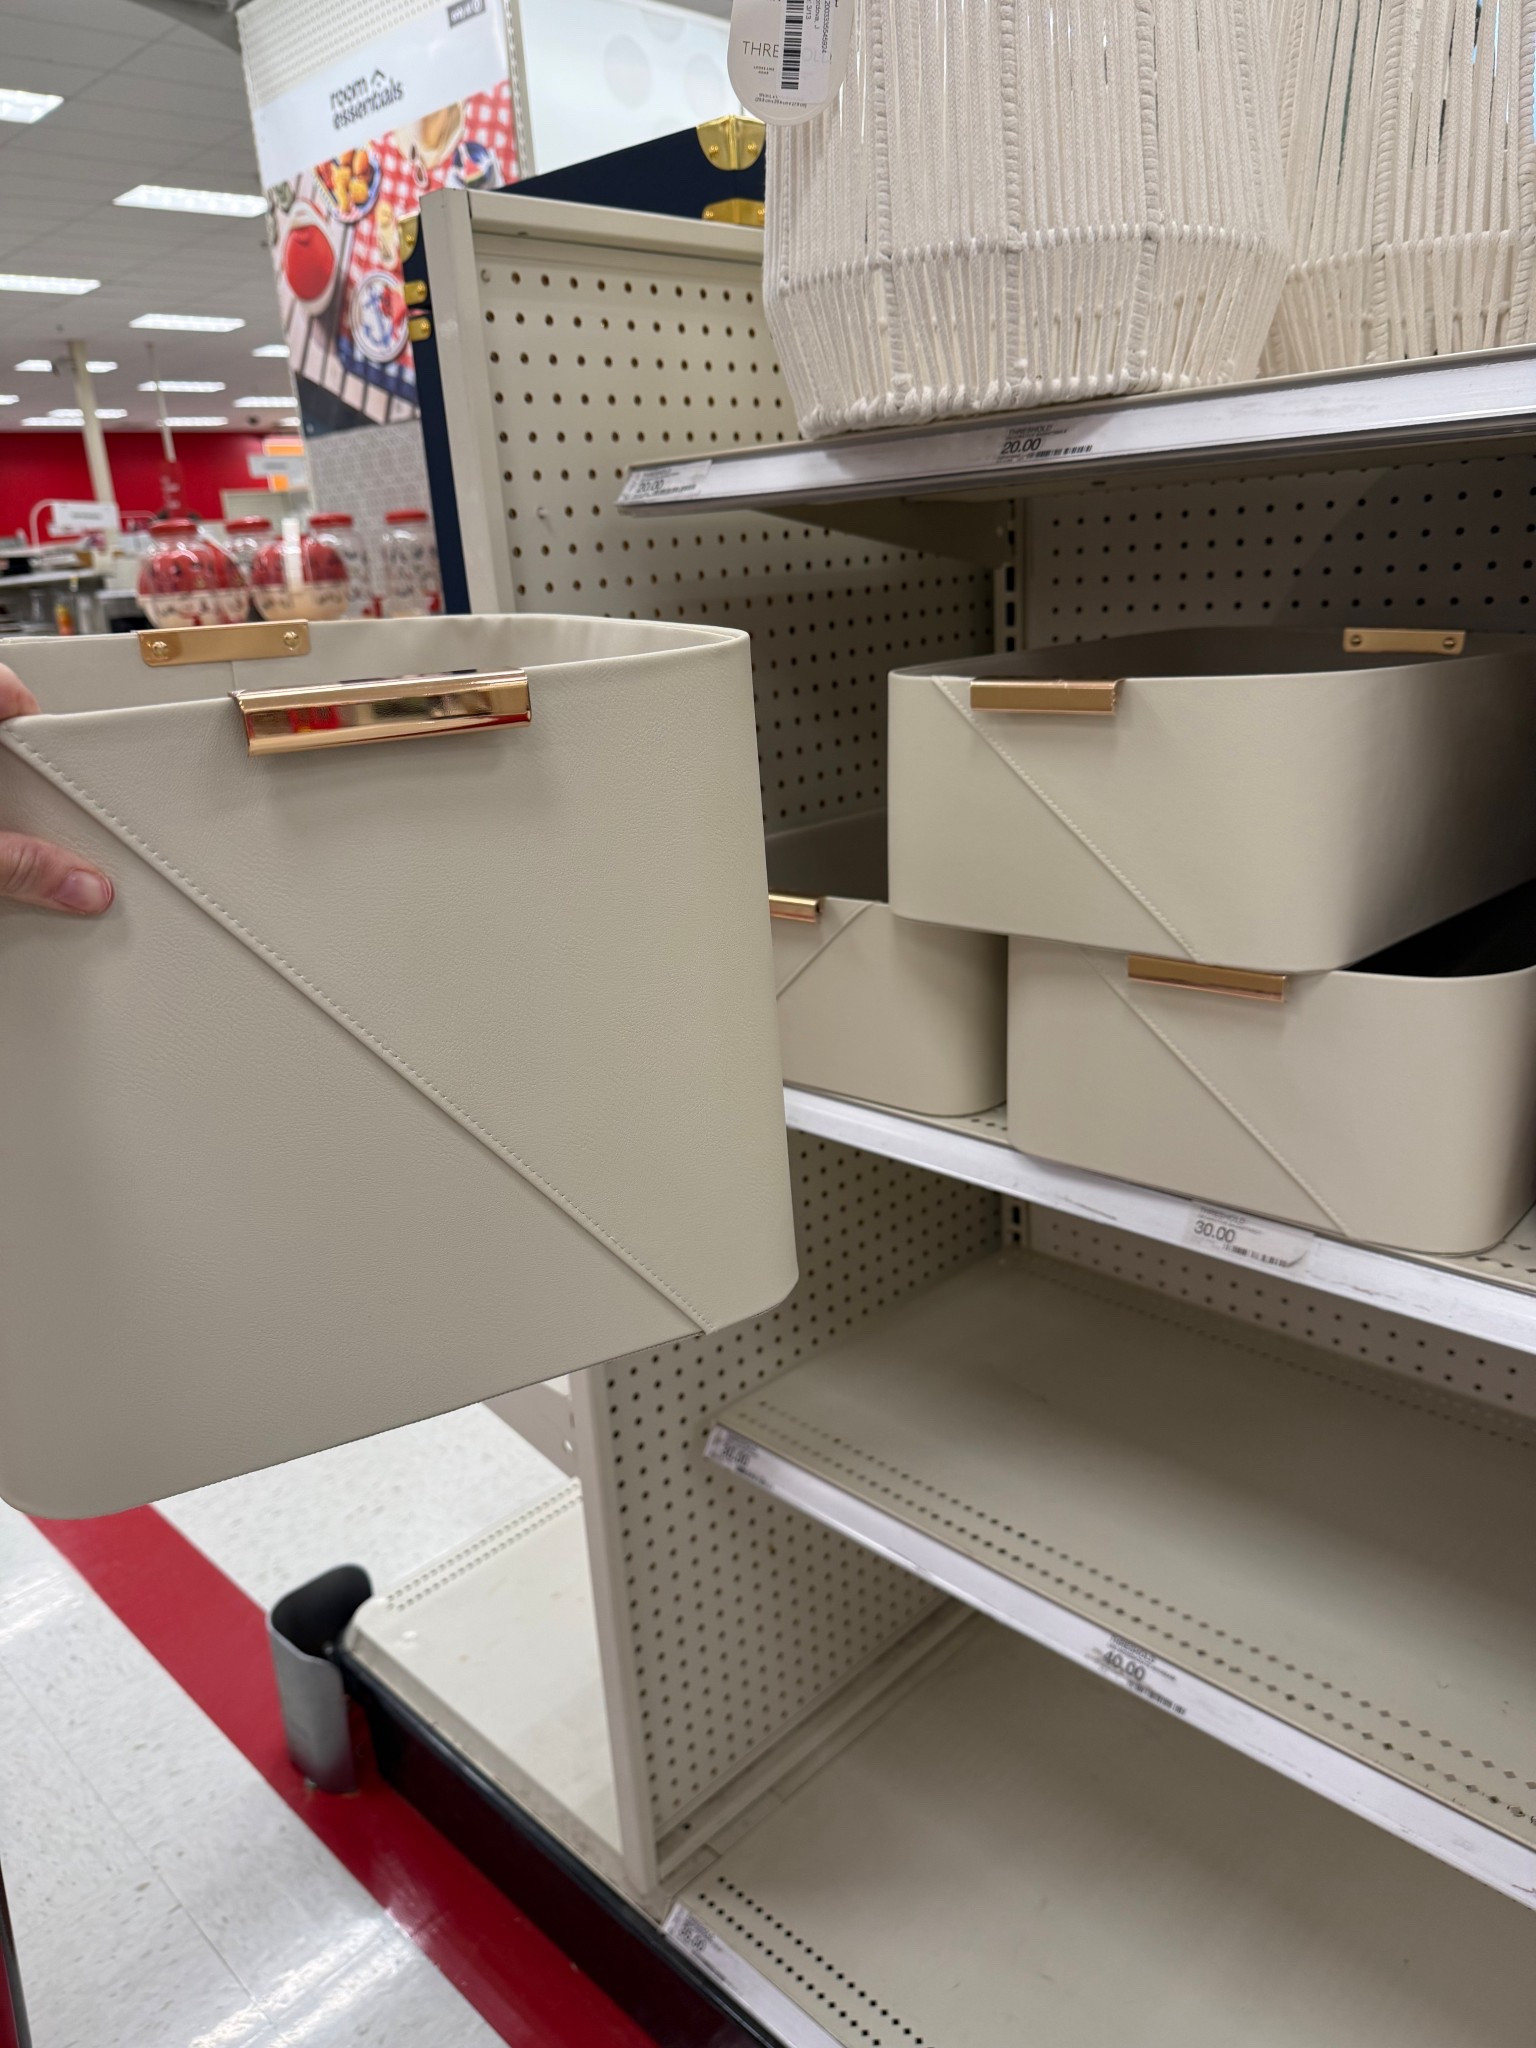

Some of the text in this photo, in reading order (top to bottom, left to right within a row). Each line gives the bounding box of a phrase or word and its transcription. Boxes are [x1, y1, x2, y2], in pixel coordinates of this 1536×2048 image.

[329, 77, 368, 110] room
[333, 77, 403, 130] essentials
[1001, 437, 1042, 454] 20.00
[1193, 1219, 1236, 1243] 30.00
[1103, 1650, 1146, 1682] 40.00
